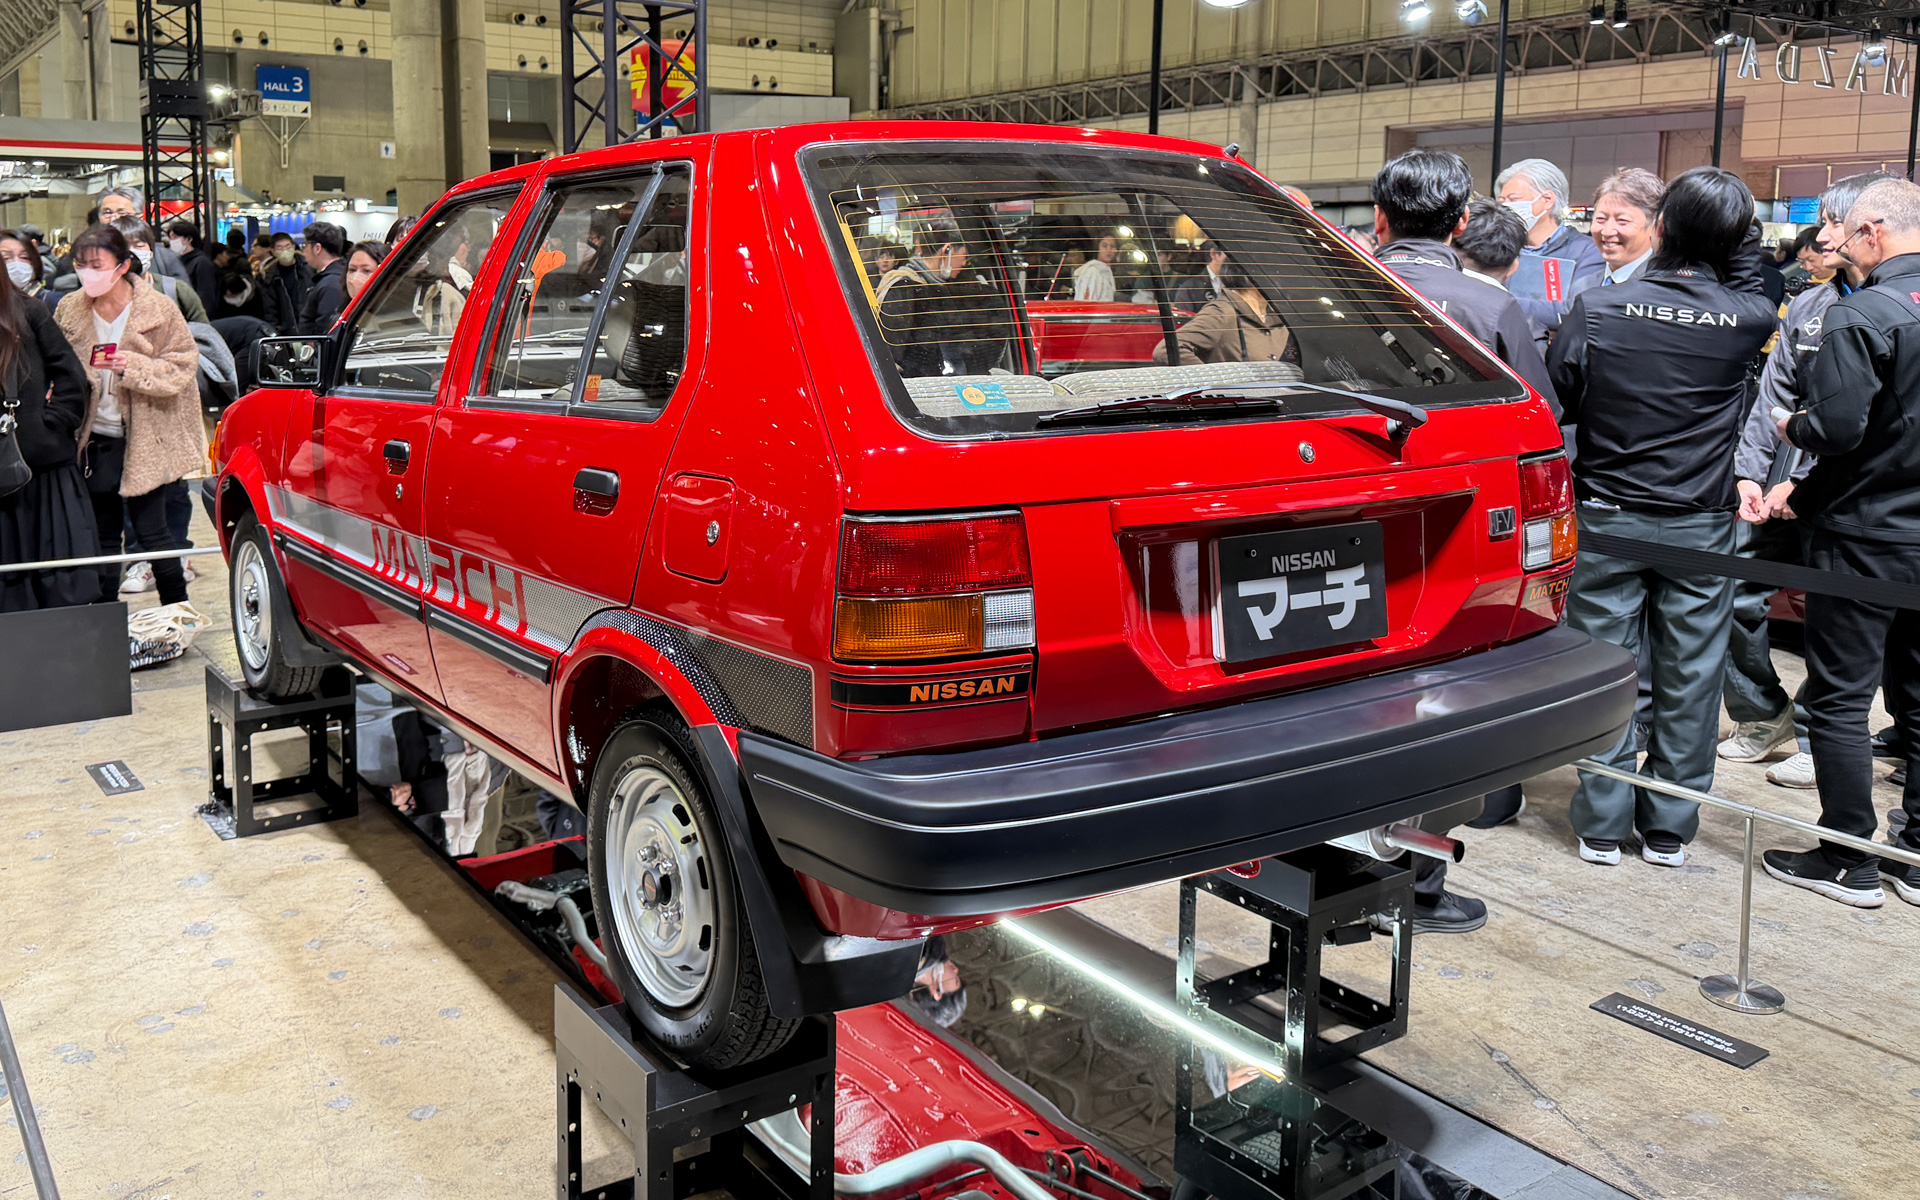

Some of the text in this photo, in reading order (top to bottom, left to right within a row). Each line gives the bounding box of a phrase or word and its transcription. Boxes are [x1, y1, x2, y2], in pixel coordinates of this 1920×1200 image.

[263, 76, 304, 93] HALL 3
[1625, 302, 1738, 328] NISSAN
[1271, 549, 1337, 574] NISSAN
[371, 523, 529, 638] MARCH
[1529, 577, 1571, 601] MATCH
[1237, 562, 1371, 641] マーチ
[909, 676, 1016, 702] NISSAN
[1632, 1005, 1731, 1046] Please do not touch
